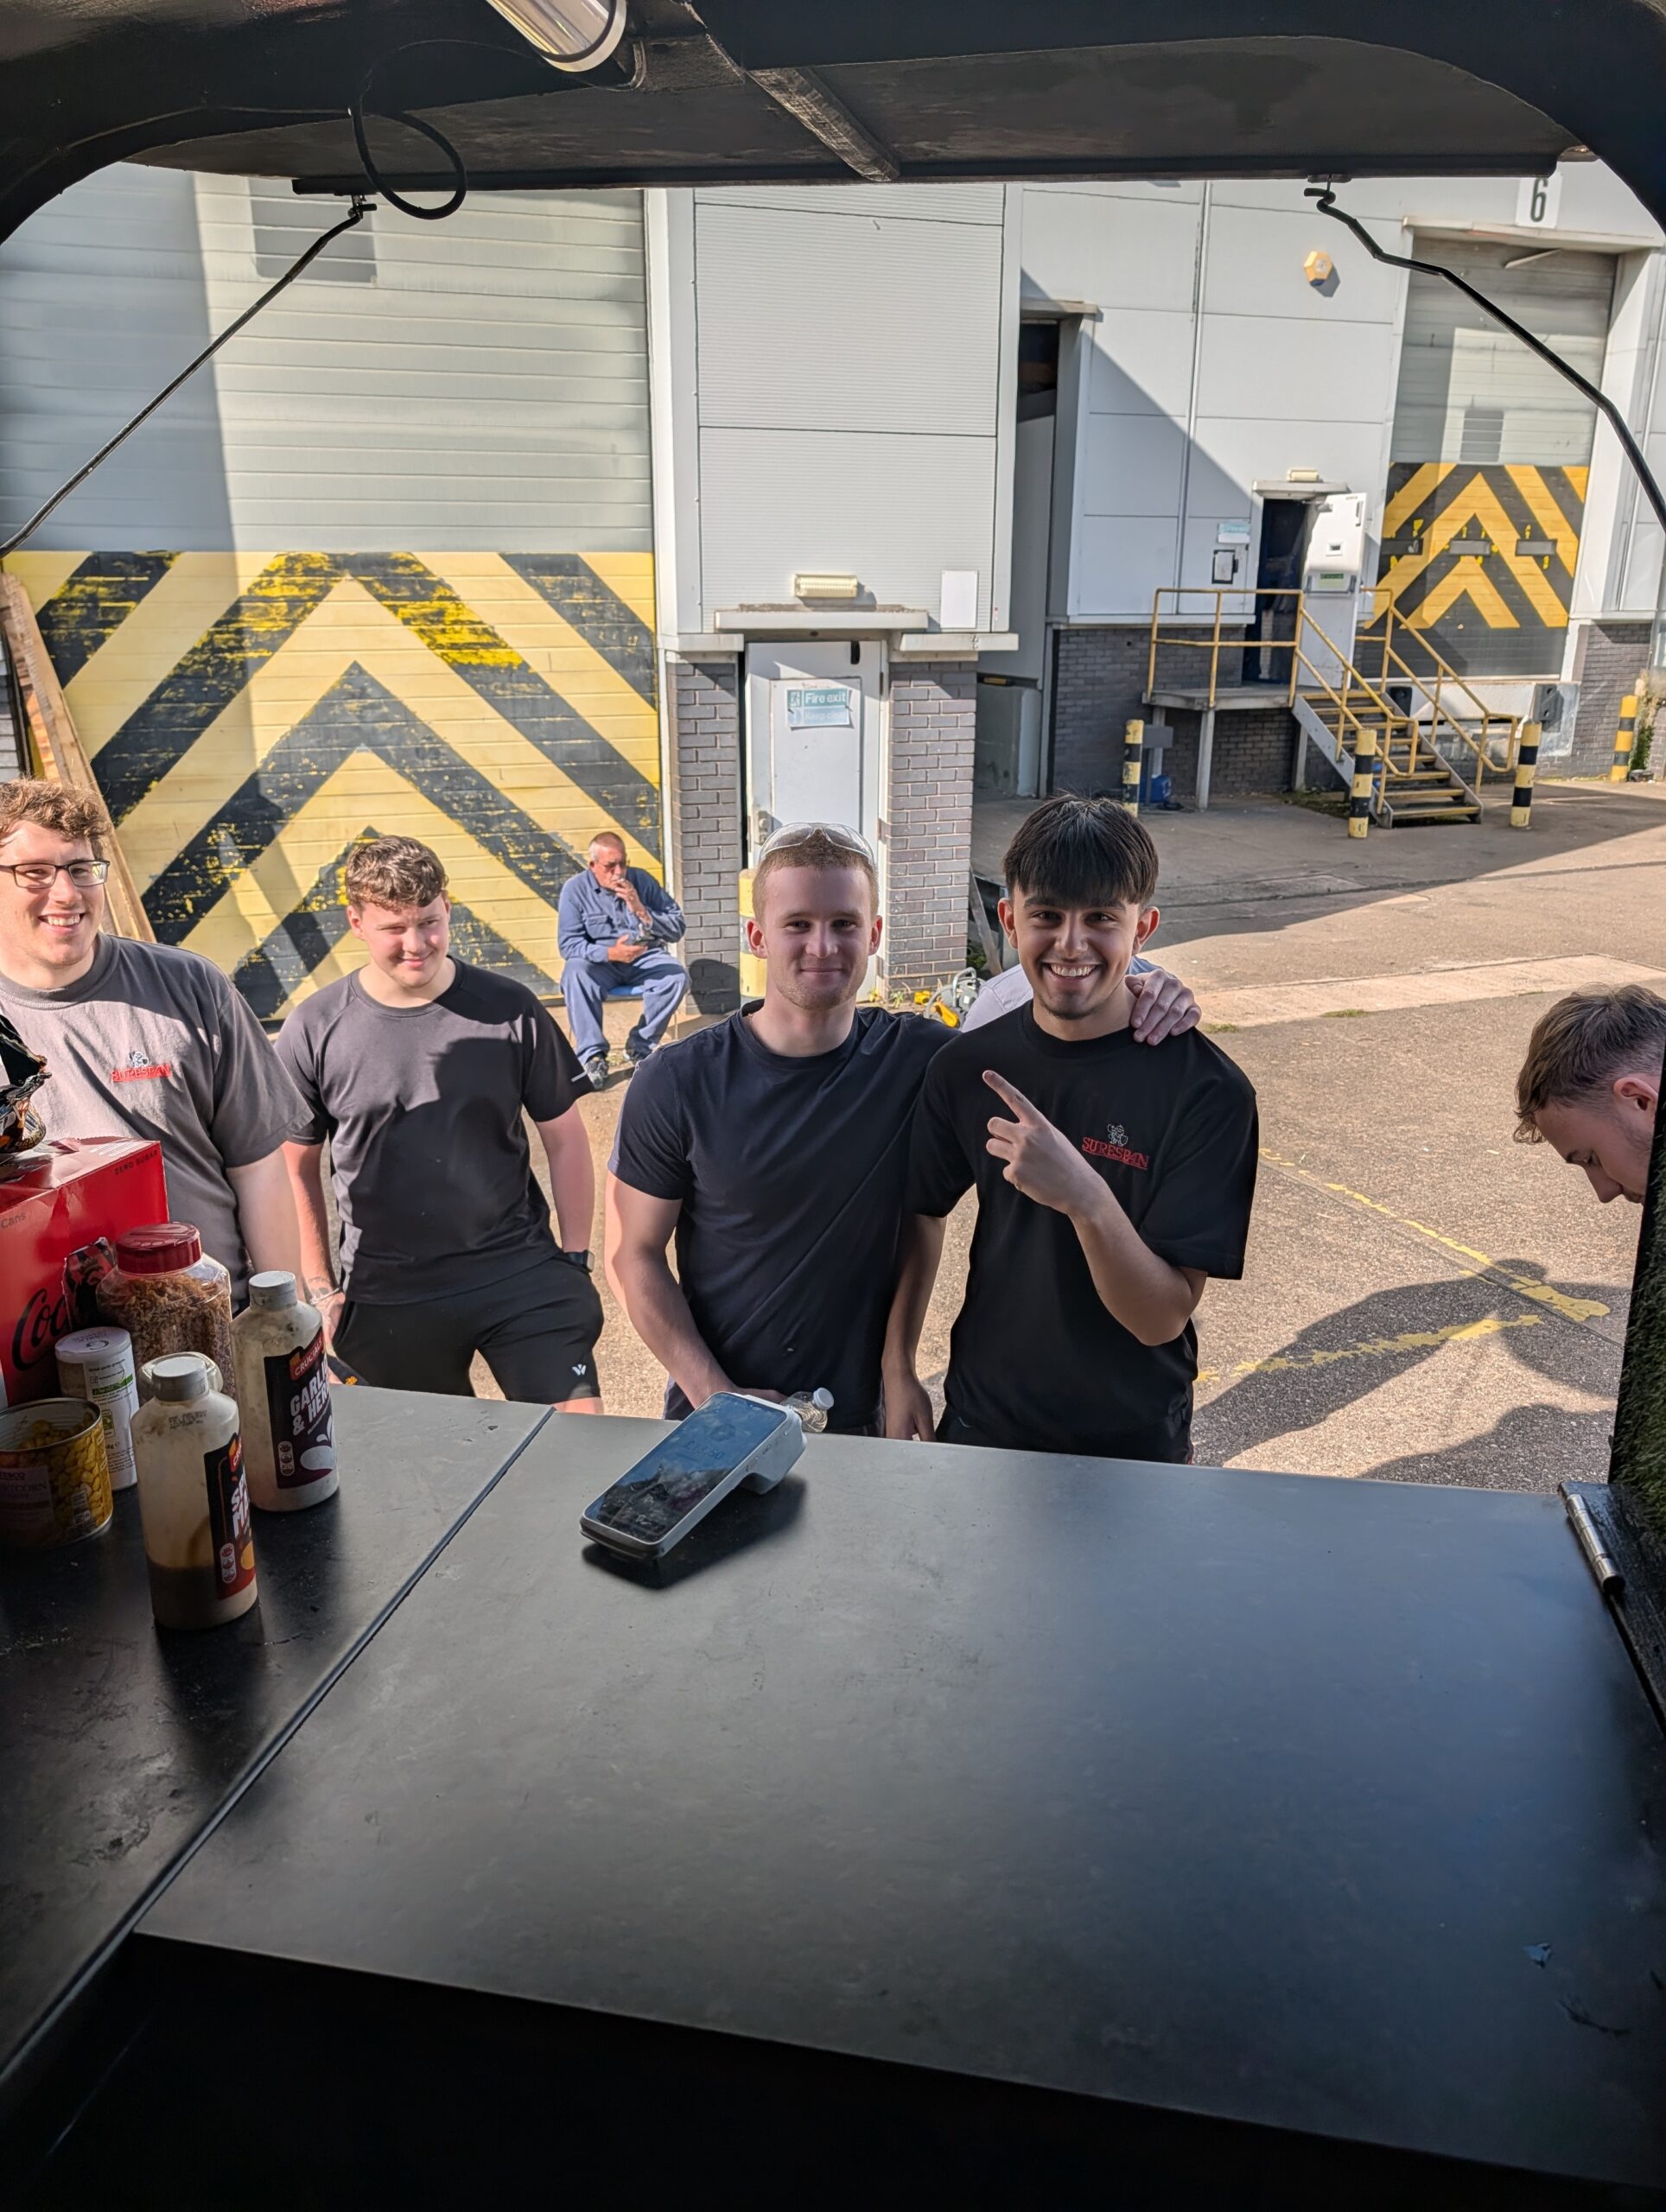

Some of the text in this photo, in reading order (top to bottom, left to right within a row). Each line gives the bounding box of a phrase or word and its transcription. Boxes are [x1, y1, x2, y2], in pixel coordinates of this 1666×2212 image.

[1530, 177, 1548, 223] 6
[805, 690, 846, 704] Fire exit
[111, 1064, 171, 1082] SURESPAN
[114, 1149, 159, 1175] ZERO SUGAR
[1082, 1136, 1149, 1170] SURESPAN
[1, 1212, 27, 1228] Cans
[292, 1414, 305, 1436] &
